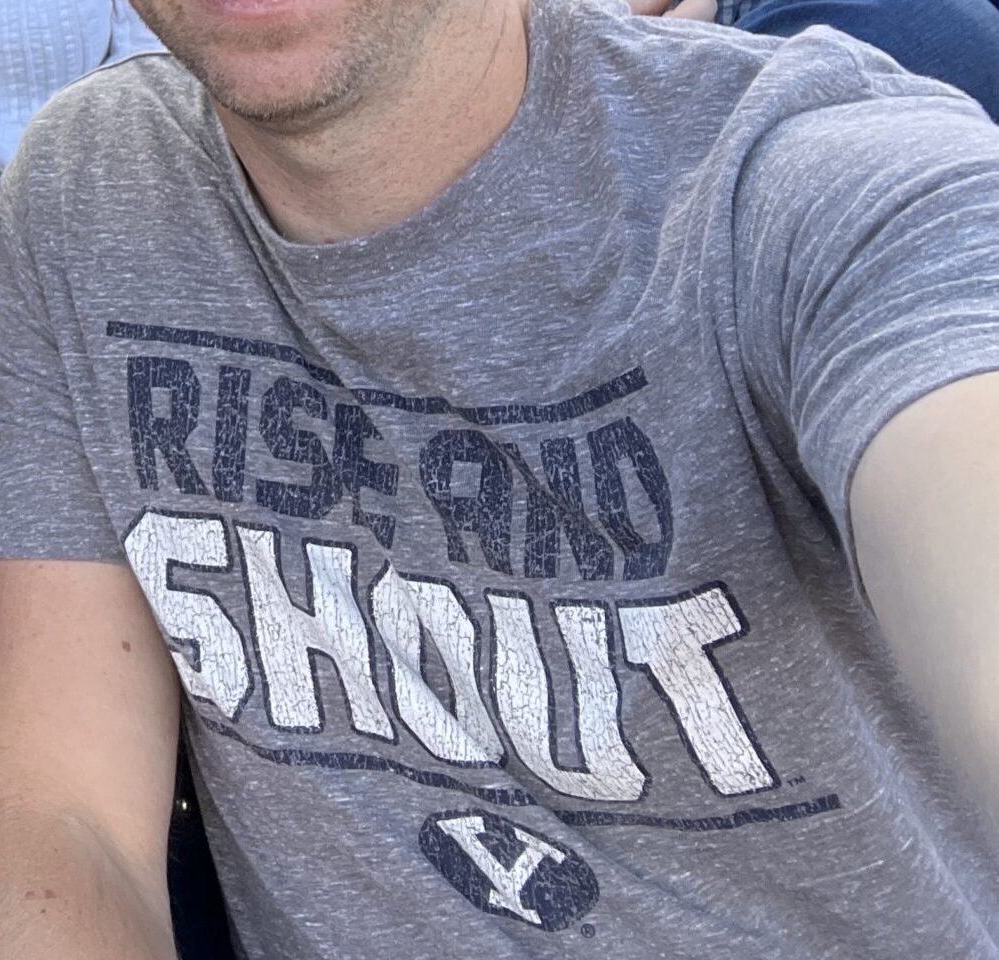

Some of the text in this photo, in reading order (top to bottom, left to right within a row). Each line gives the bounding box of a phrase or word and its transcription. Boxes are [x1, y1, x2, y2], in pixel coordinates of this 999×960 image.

[126, 355, 674, 581] RISE AND
[122, 507, 780, 803] SHOUT
[436, 816, 567, 925] Y
